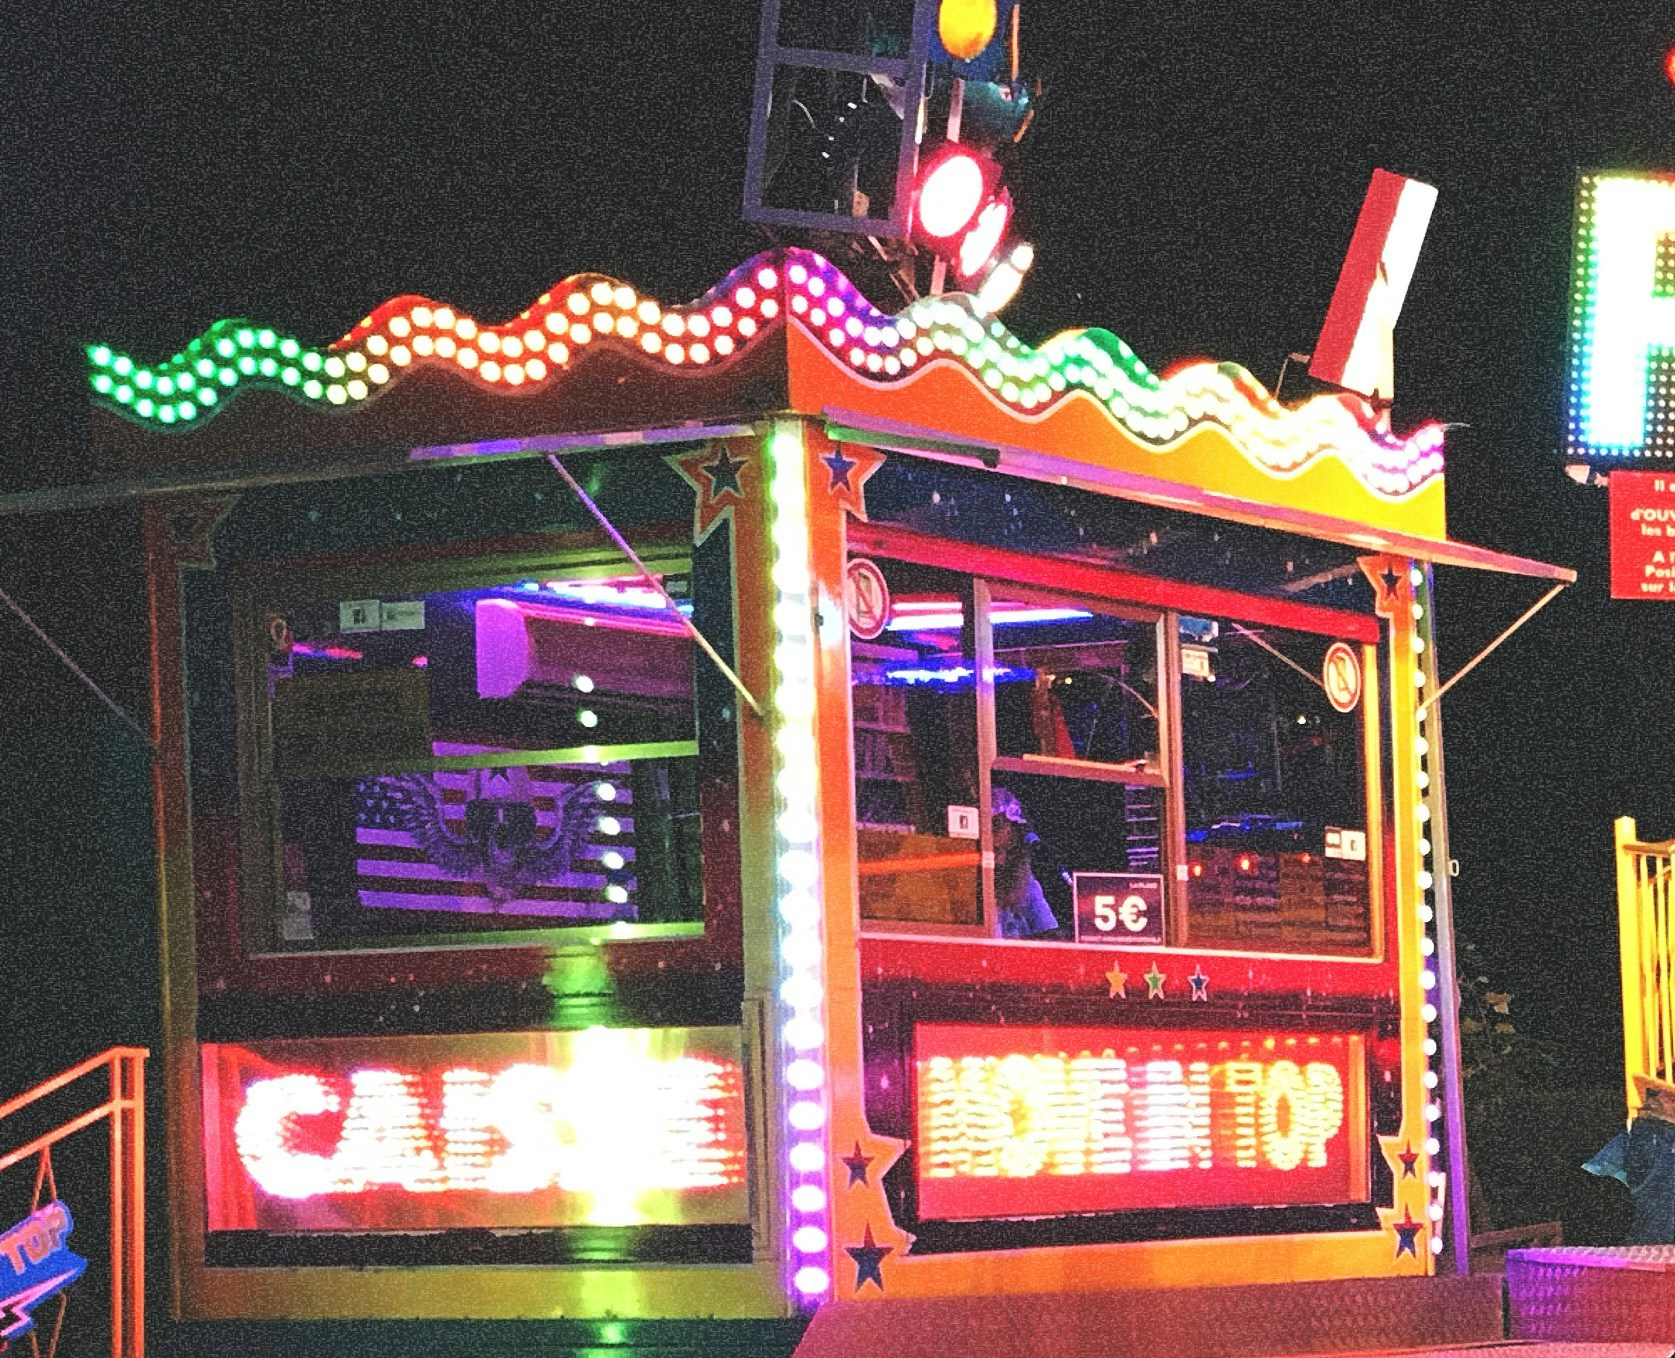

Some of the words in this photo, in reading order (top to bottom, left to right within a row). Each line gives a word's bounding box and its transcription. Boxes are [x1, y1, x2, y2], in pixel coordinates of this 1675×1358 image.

[1654, 479, 1665, 492] Il
[1641, 522, 1662, 537] les
[1652, 550, 1666, 564] A
[1641, 582, 1664, 593] sur
[1094, 895, 1149, 932] 5€
[1224, 1060, 1344, 1171] TOP
